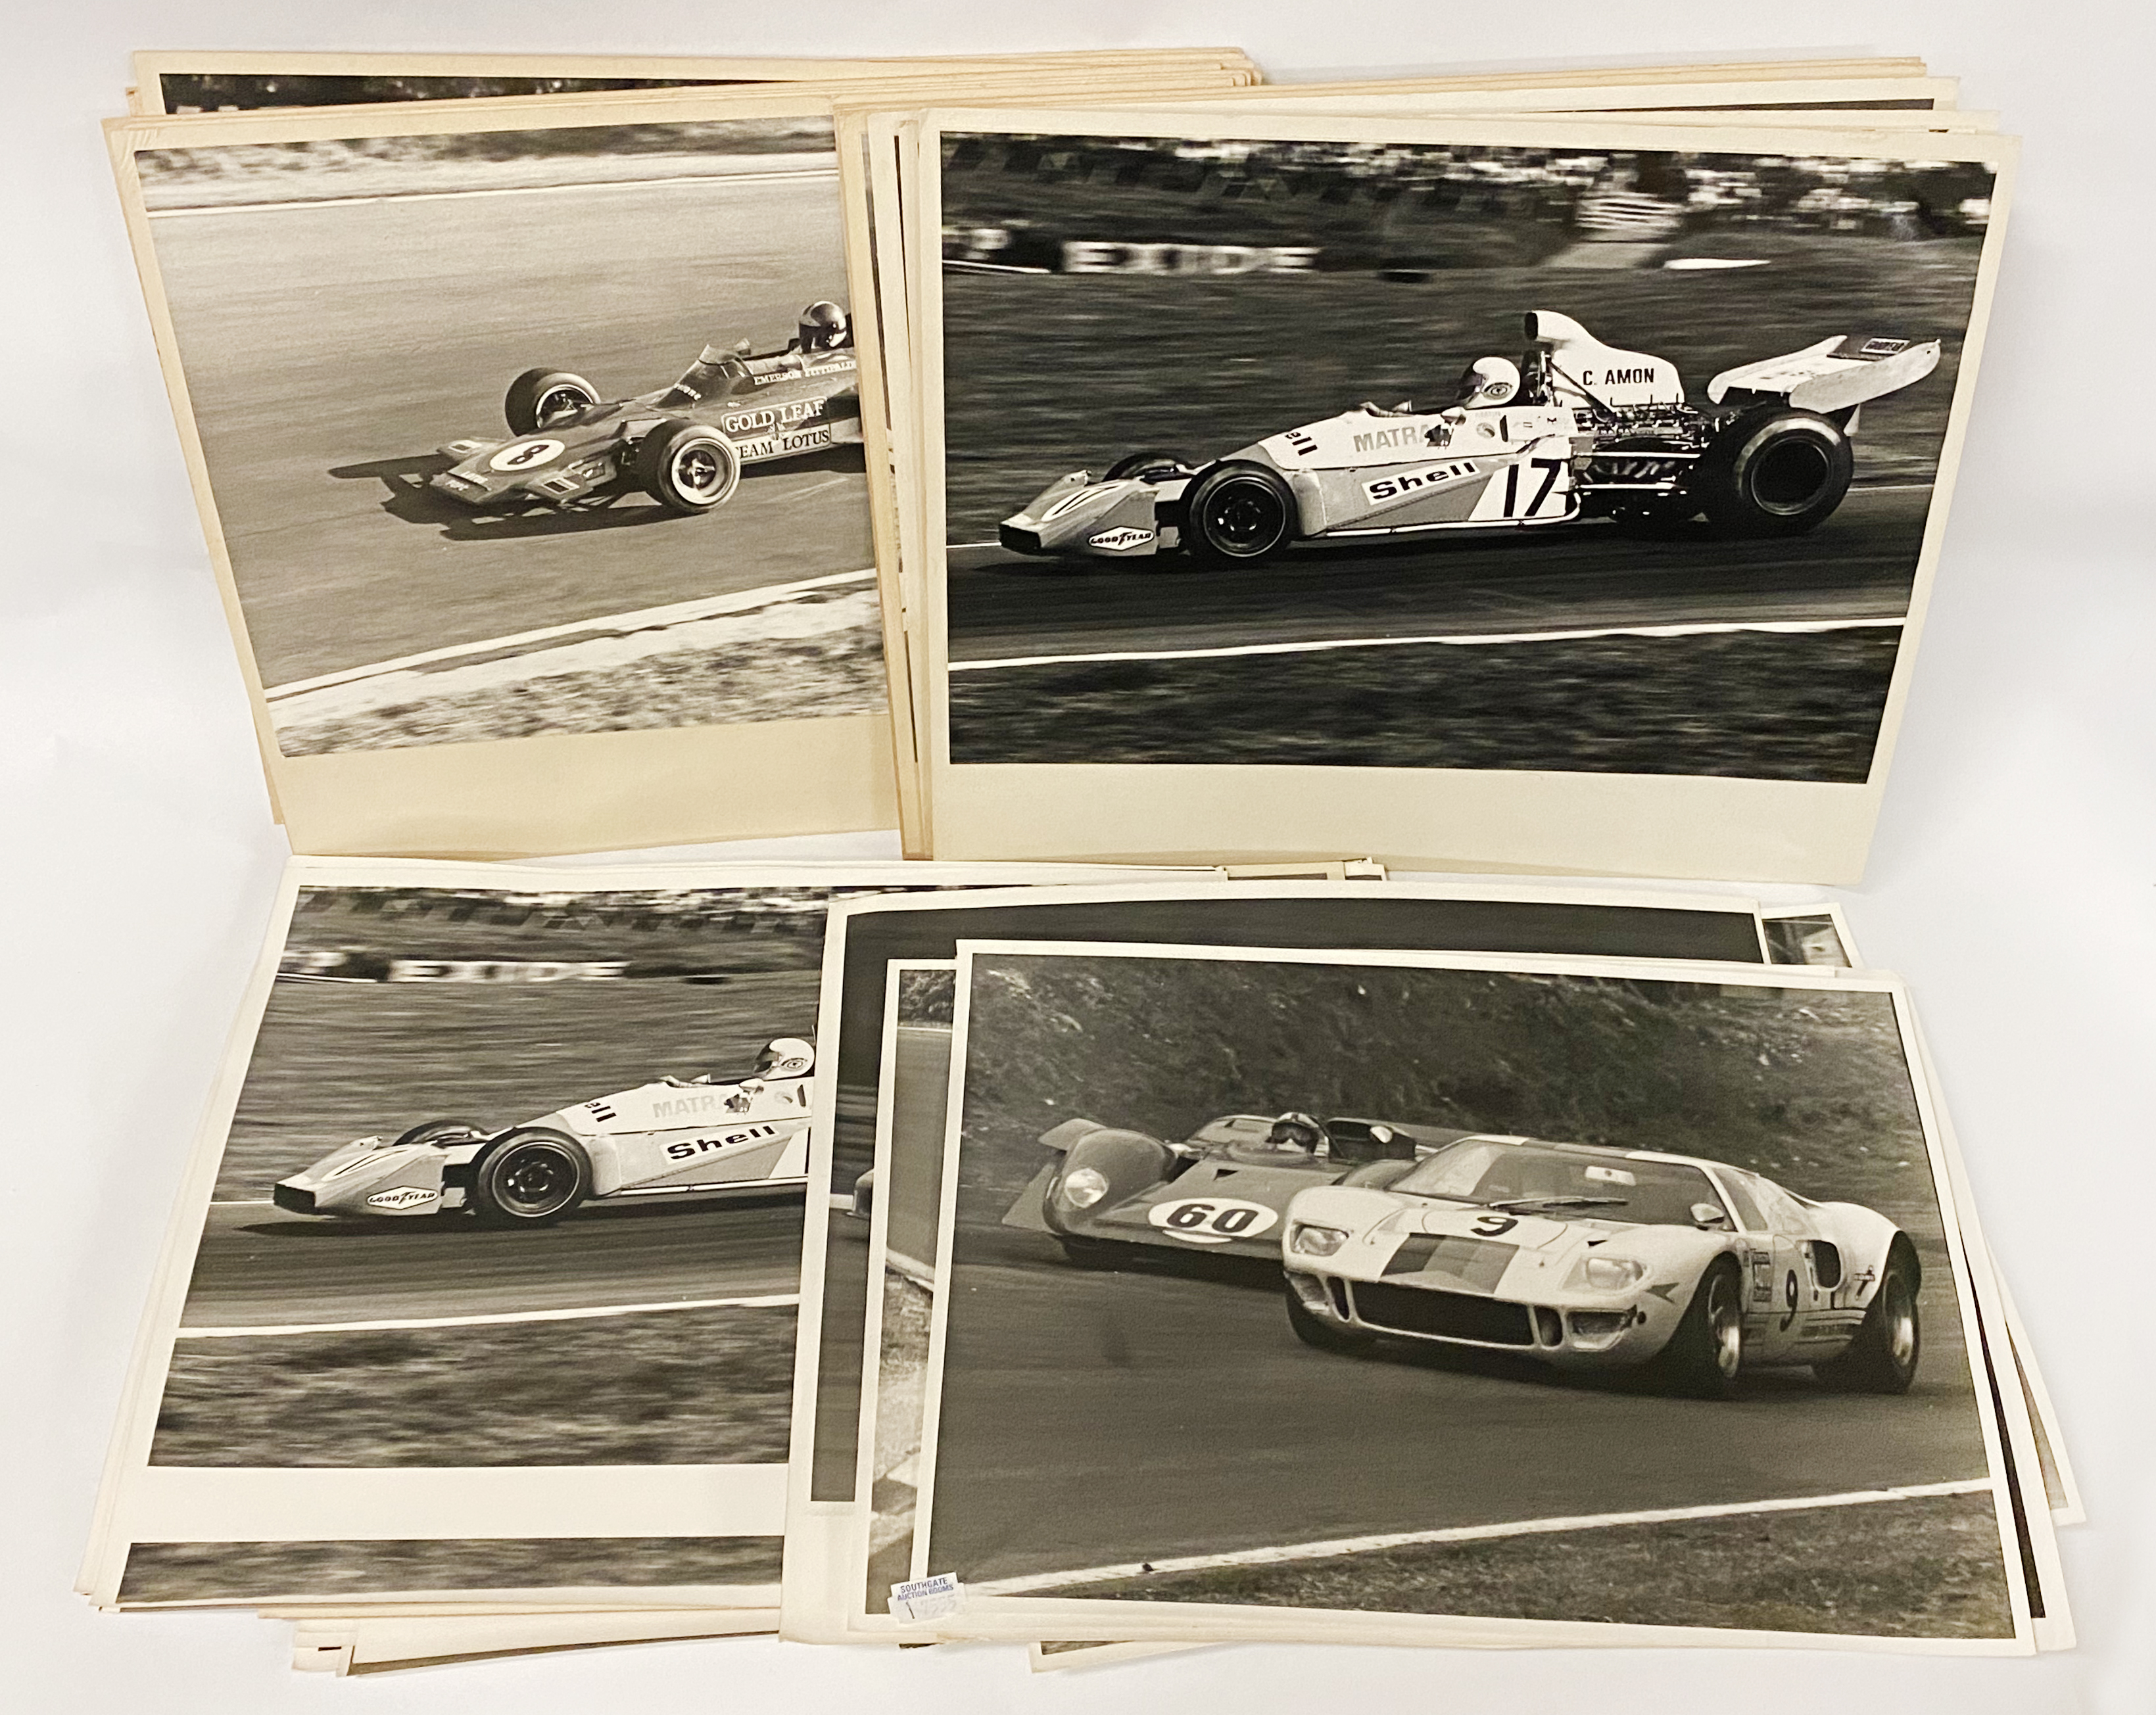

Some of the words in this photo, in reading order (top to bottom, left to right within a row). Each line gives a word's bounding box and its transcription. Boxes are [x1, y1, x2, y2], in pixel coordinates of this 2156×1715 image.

[754, 369, 802, 385] EMERSON
[1605, 368, 1654, 385] AMON
[725, 411, 775, 433] GOLD
[780, 400, 826, 424] LEAF
[782, 429, 830, 450] LOTUS
[506, 444, 550, 465] 8
[1370, 462, 1475, 500] Shell
[1503, 458, 1562, 518] 17
[667, 1125, 776, 1160] Shell
[1166, 1204, 1259, 1233] 60
[1470, 1216, 1519, 1237] 9
[1779, 1269, 1798, 1332] 9
[898, 1590, 928, 1601] AUCTION
[900, 1577, 948, 1593] SOUTHGATE
